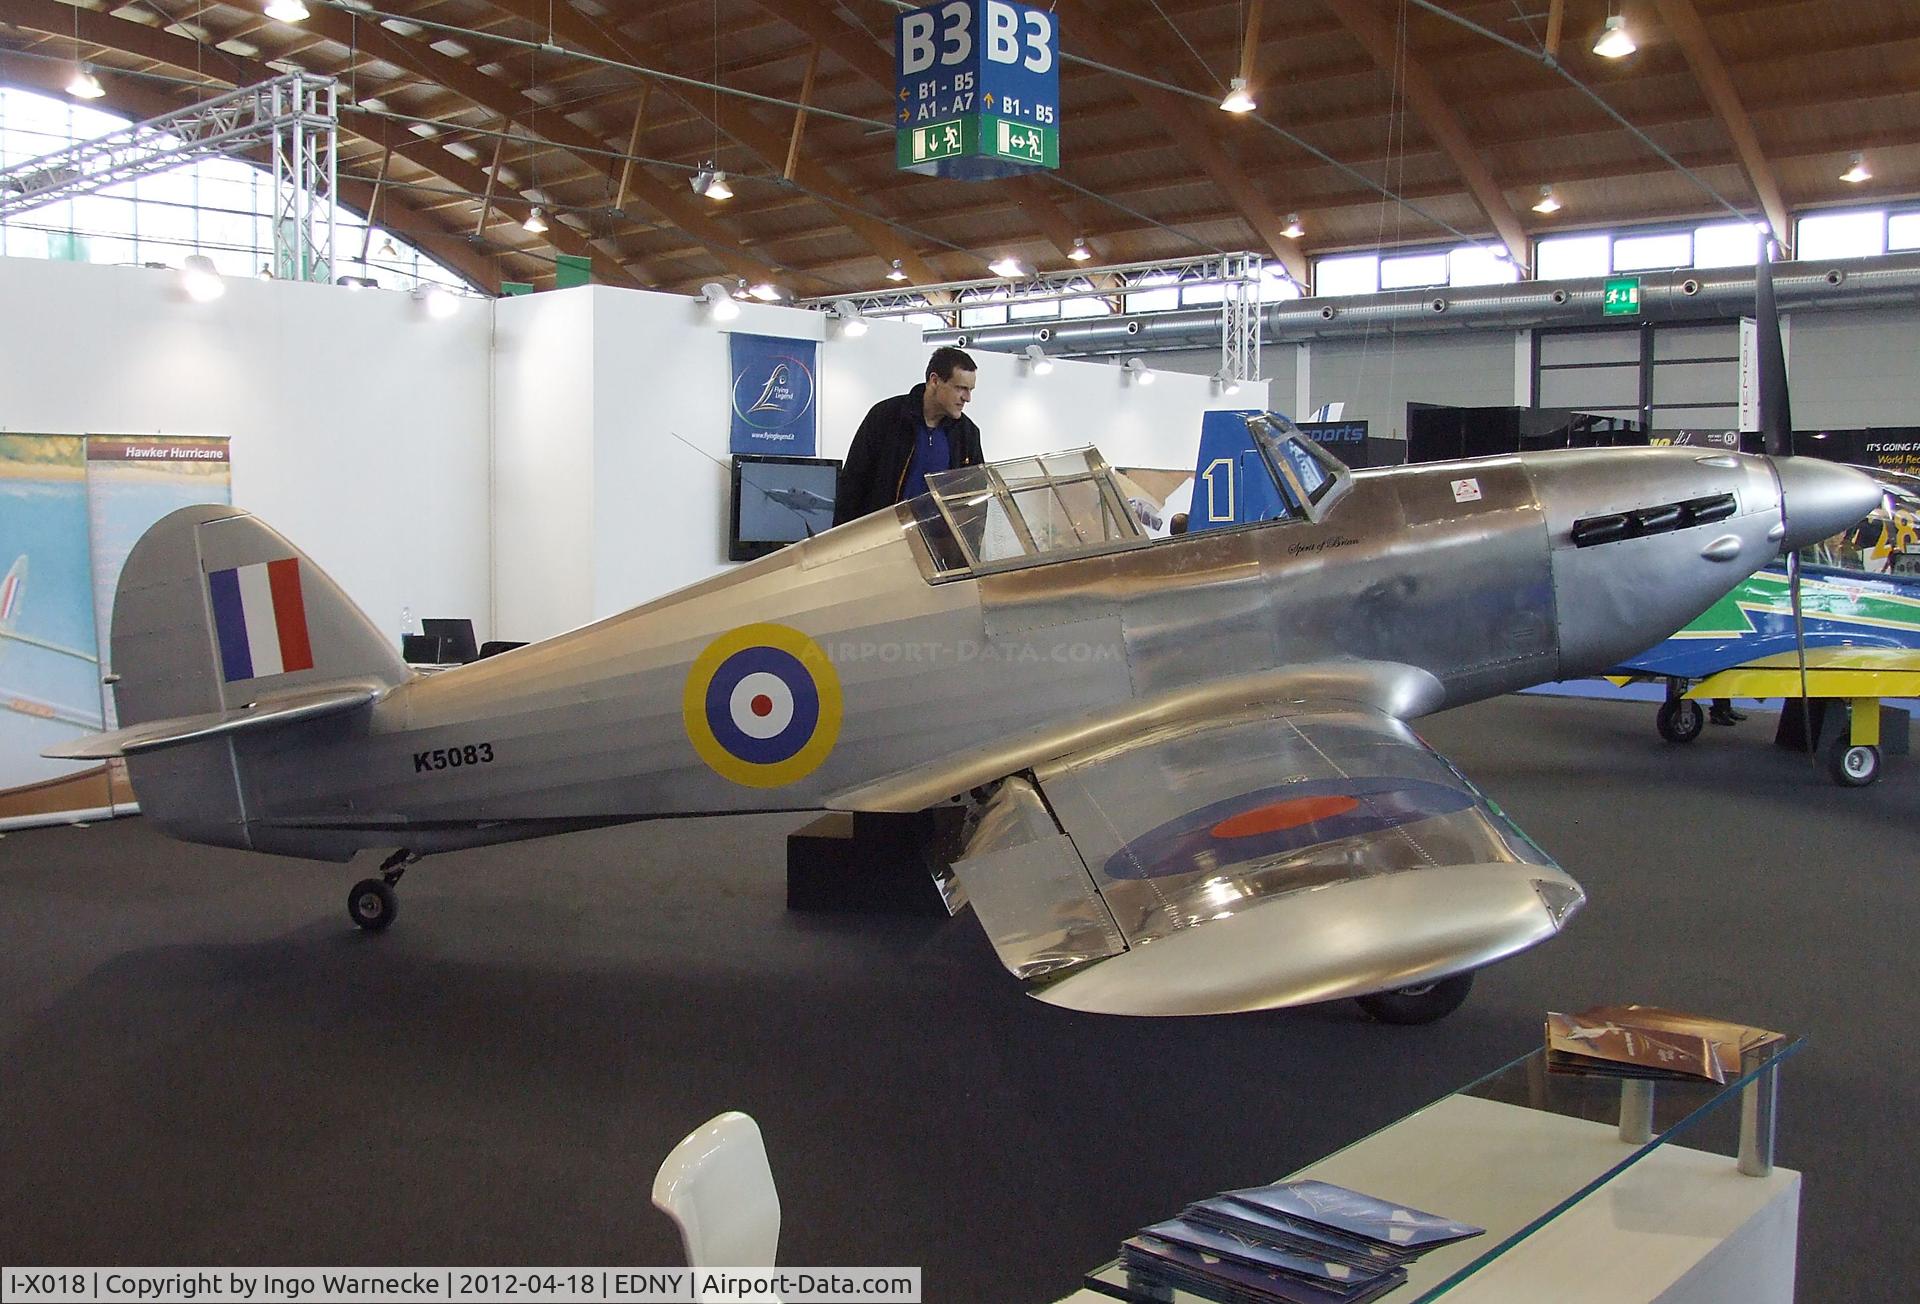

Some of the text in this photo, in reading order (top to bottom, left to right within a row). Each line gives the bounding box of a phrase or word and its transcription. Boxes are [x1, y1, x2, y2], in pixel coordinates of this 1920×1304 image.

[903, 1, 972, 75] B3
[988, 0, 1052, 73] B3
[919, 80, 937, 100] B1
[954, 72, 974, 92] B5
[917, 101, 937, 121] A1
[952, 93, 974, 114] A7
[1003, 96, 1020, 116] B1
[1036, 104, 1053, 124] B5
[774, 386, 789, 395] Flying
[126, 447, 224, 459] Hawker Hurricane
[1866, 443, 1881, 452] IT'S
[1882, 443, 1910, 452] GOING
[1878, 454, 1904, 464] World
[1202, 458, 1234, 522] 1
[1288, 542, 1315, 557] Spirit
[1316, 541, 1326, 553] of
[413, 743, 494, 773] K5083
